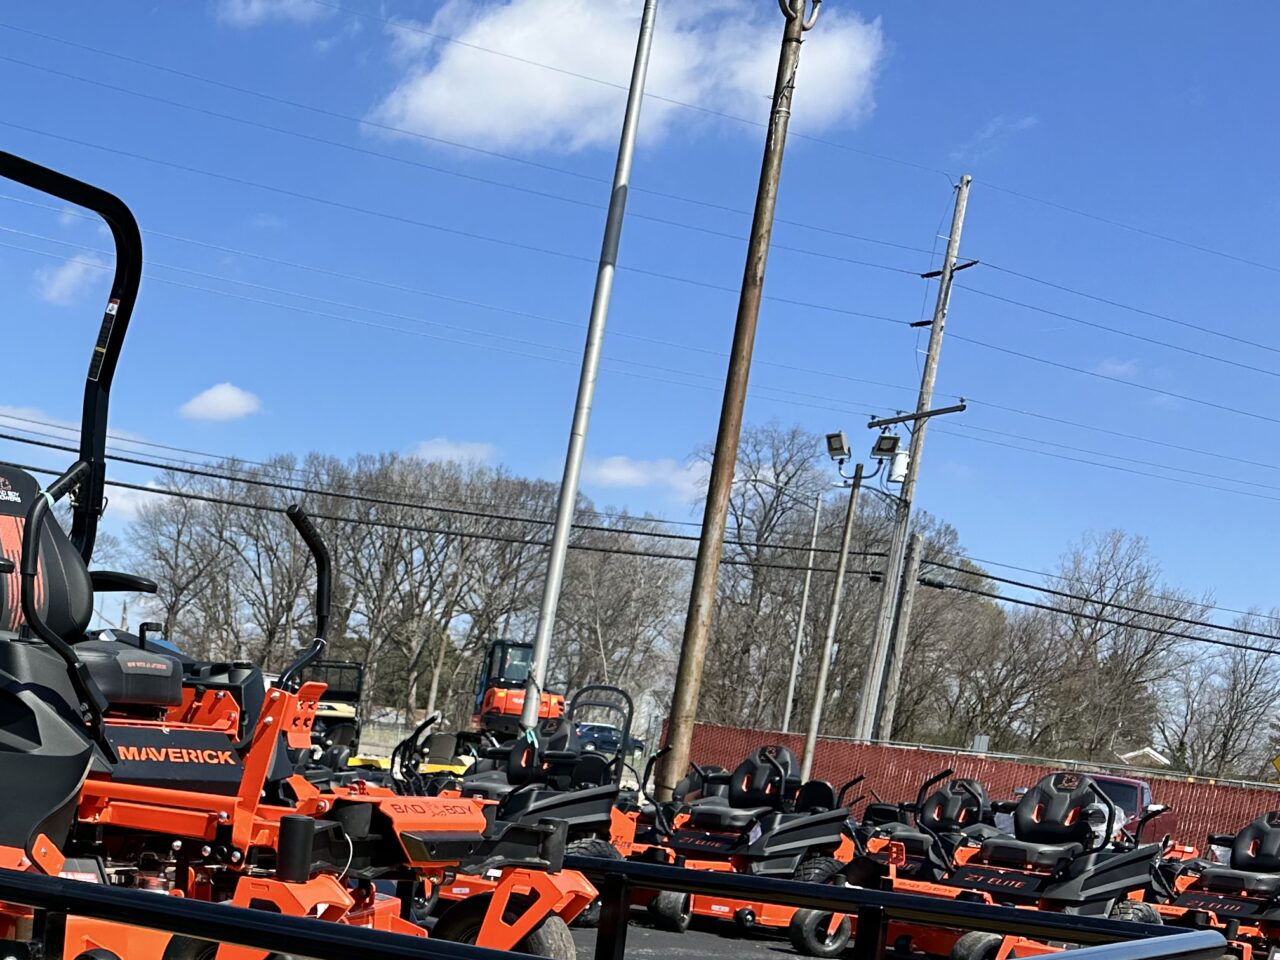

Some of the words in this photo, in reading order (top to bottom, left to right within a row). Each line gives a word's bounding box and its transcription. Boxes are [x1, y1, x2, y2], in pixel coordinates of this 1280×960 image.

[117, 745, 237, 766] MAVERICK
[390, 803, 426, 815] BAD
[442, 804, 474, 817] BOY
